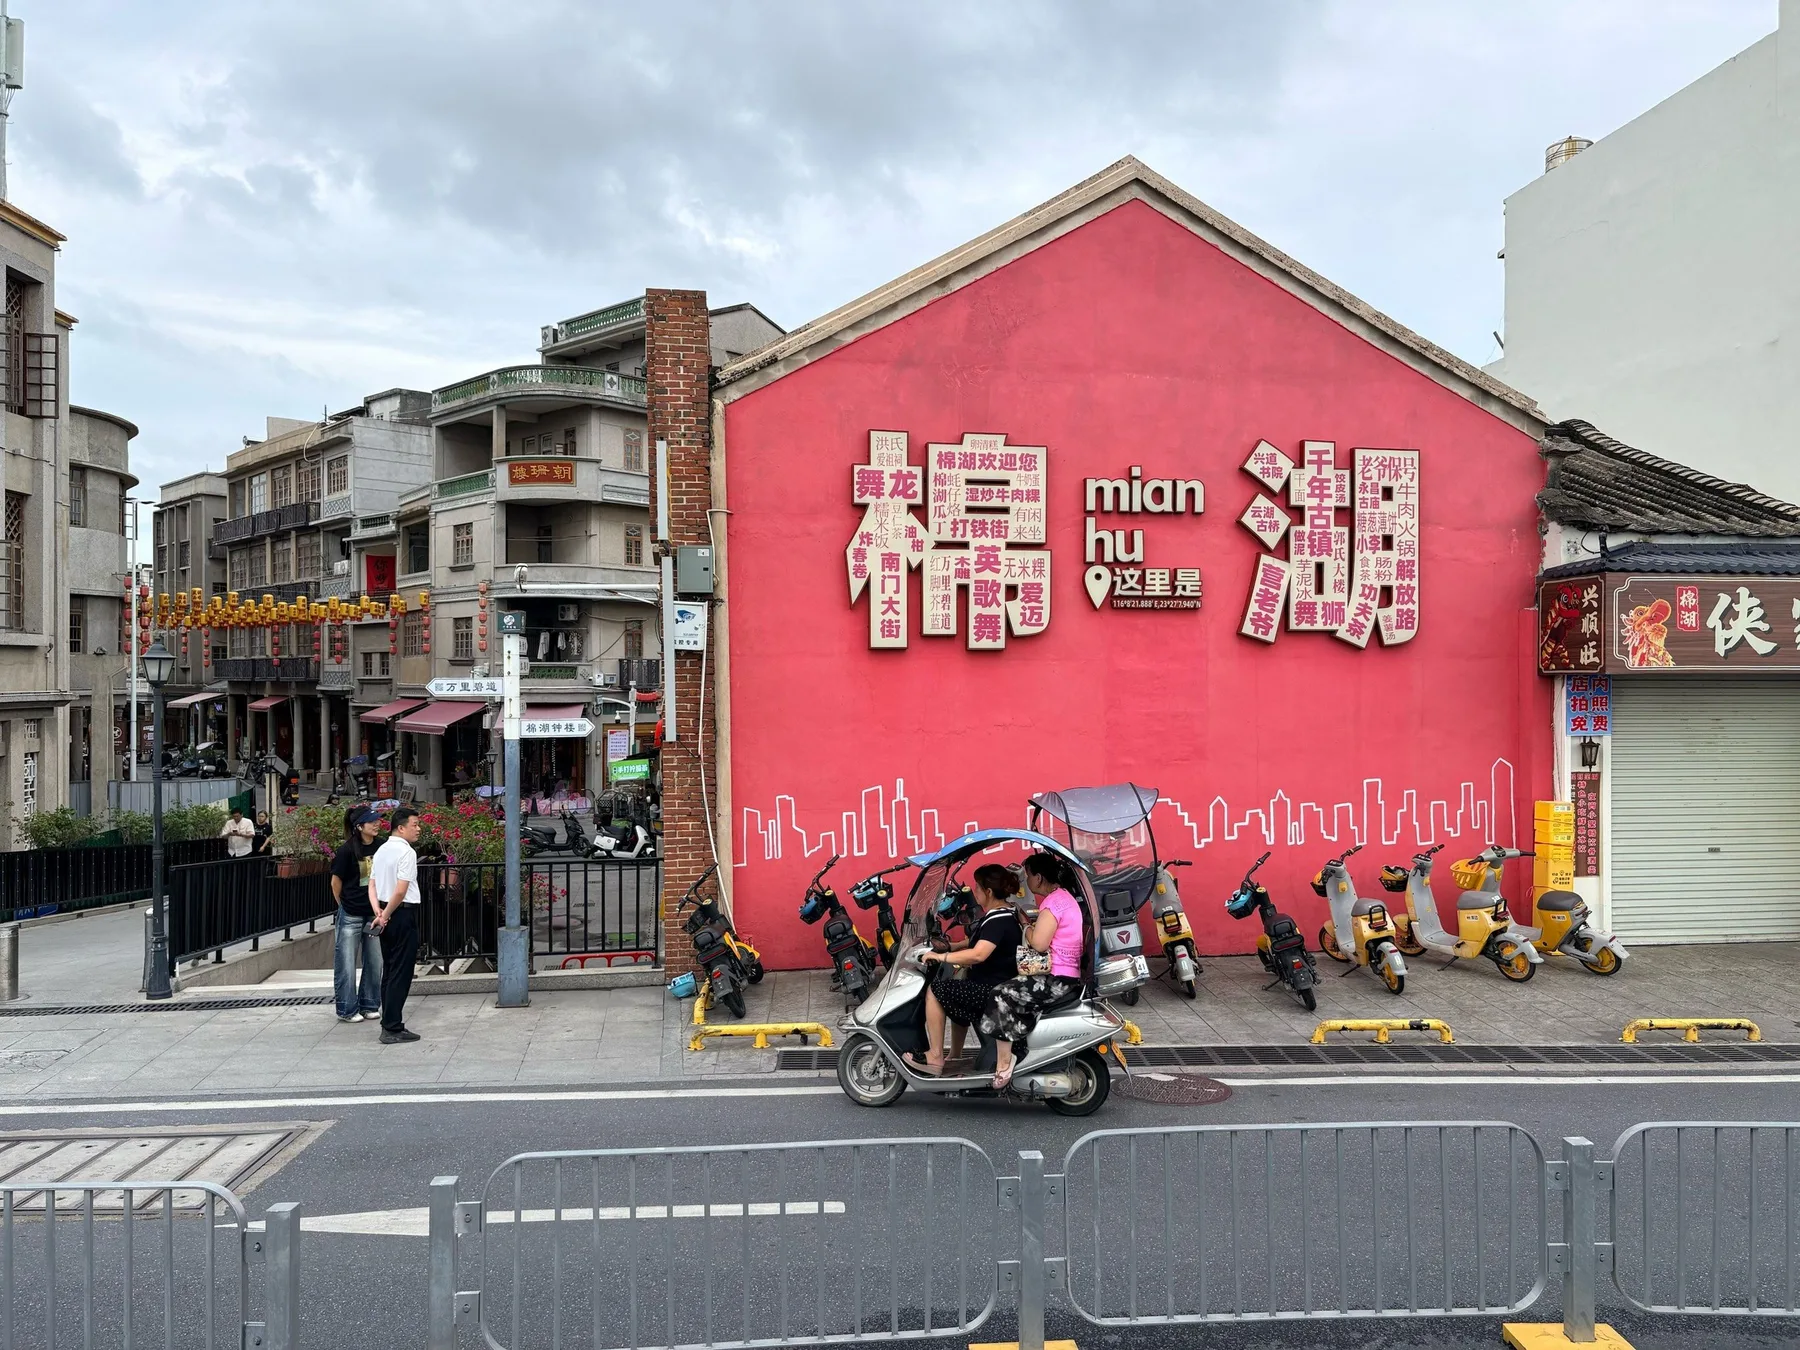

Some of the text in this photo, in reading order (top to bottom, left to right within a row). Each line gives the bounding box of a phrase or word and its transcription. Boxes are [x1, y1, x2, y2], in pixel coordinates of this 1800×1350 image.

[875, 436, 904, 452] 洪氏
[936, 450, 1038, 472] 棉湖欢迎您
[1253, 452, 1278, 465] 兴道
[1258, 466, 1284, 479] 书院
[1357, 455, 1417, 483] 老爷保号
[855, 468, 919, 500] 舞龙
[1016, 473, 1040, 487] 牛奶蛋
[1085, 465, 1205, 513] mian
[1294, 473, 1306, 503] 干面
[1334, 473, 1347, 503] 饺皮汤
[1358, 481, 1380, 495] 永昌
[932, 472, 947, 535] 棉湖瓜丁
[946, 473, 961, 517] 蚝仔烙
[964, 487, 1041, 503] 湿炒牛肉粿
[1306, 449, 1334, 558] 千年古镇
[1358, 496, 1380, 510] 古庙
[873, 502, 890, 549] 糯米饭
[891, 503, 904, 540] 豆仁茶
[1014, 507, 1042, 523] 有闲
[1250, 506, 1276, 519] 云湖
[1255, 520, 1281, 533] 古桥
[1356, 511, 1398, 534] 糖葱薄饼
[1396, 482, 1417, 558] 牛肉火锅
[904, 525, 925, 553] 油柑
[949, 518, 1010, 540] 打铁街
[1013, 524, 1042, 540] 来坐
[1085, 516, 1144, 563] hu
[1293, 529, 1306, 556] 做泥
[852, 531, 874, 579] 炸春卷
[1356, 533, 1381, 555] 小李
[953, 556, 971, 580] 木雕
[1003, 557, 1047, 580] 无米粿
[1332, 530, 1346, 594] 郭氏大楼
[1374, 556, 1393, 581] 肠粉
[940, 555, 951, 630] 万里碧道
[972, 544, 1002, 643] 英歌舞
[1112, 567, 1203, 597] 这里是
[1295, 559, 1313, 600] 芋泥冰
[879, 551, 901, 639] 南门大街
[1019, 582, 1045, 628] 爱迈
[1249, 562, 1286, 637] 营老爷
[1394, 558, 1417, 631] 解放路
[1293, 601, 1346, 627] 舞狮
[1345, 583, 1379, 640] 功夫茶
[1679, 590, 1698, 629] 棉湖
[1706, 586, 1800, 657] 侠
[1579, 584, 1601, 666] 兴顺旺
[446, 681, 498, 692] 万里碧道
[1570, 676, 1609, 693] 店内
[1570, 695, 1609, 712] 拍照
[525, 722, 576, 733] 棉湖钟楼
[1570, 715, 1609, 732] 免费
